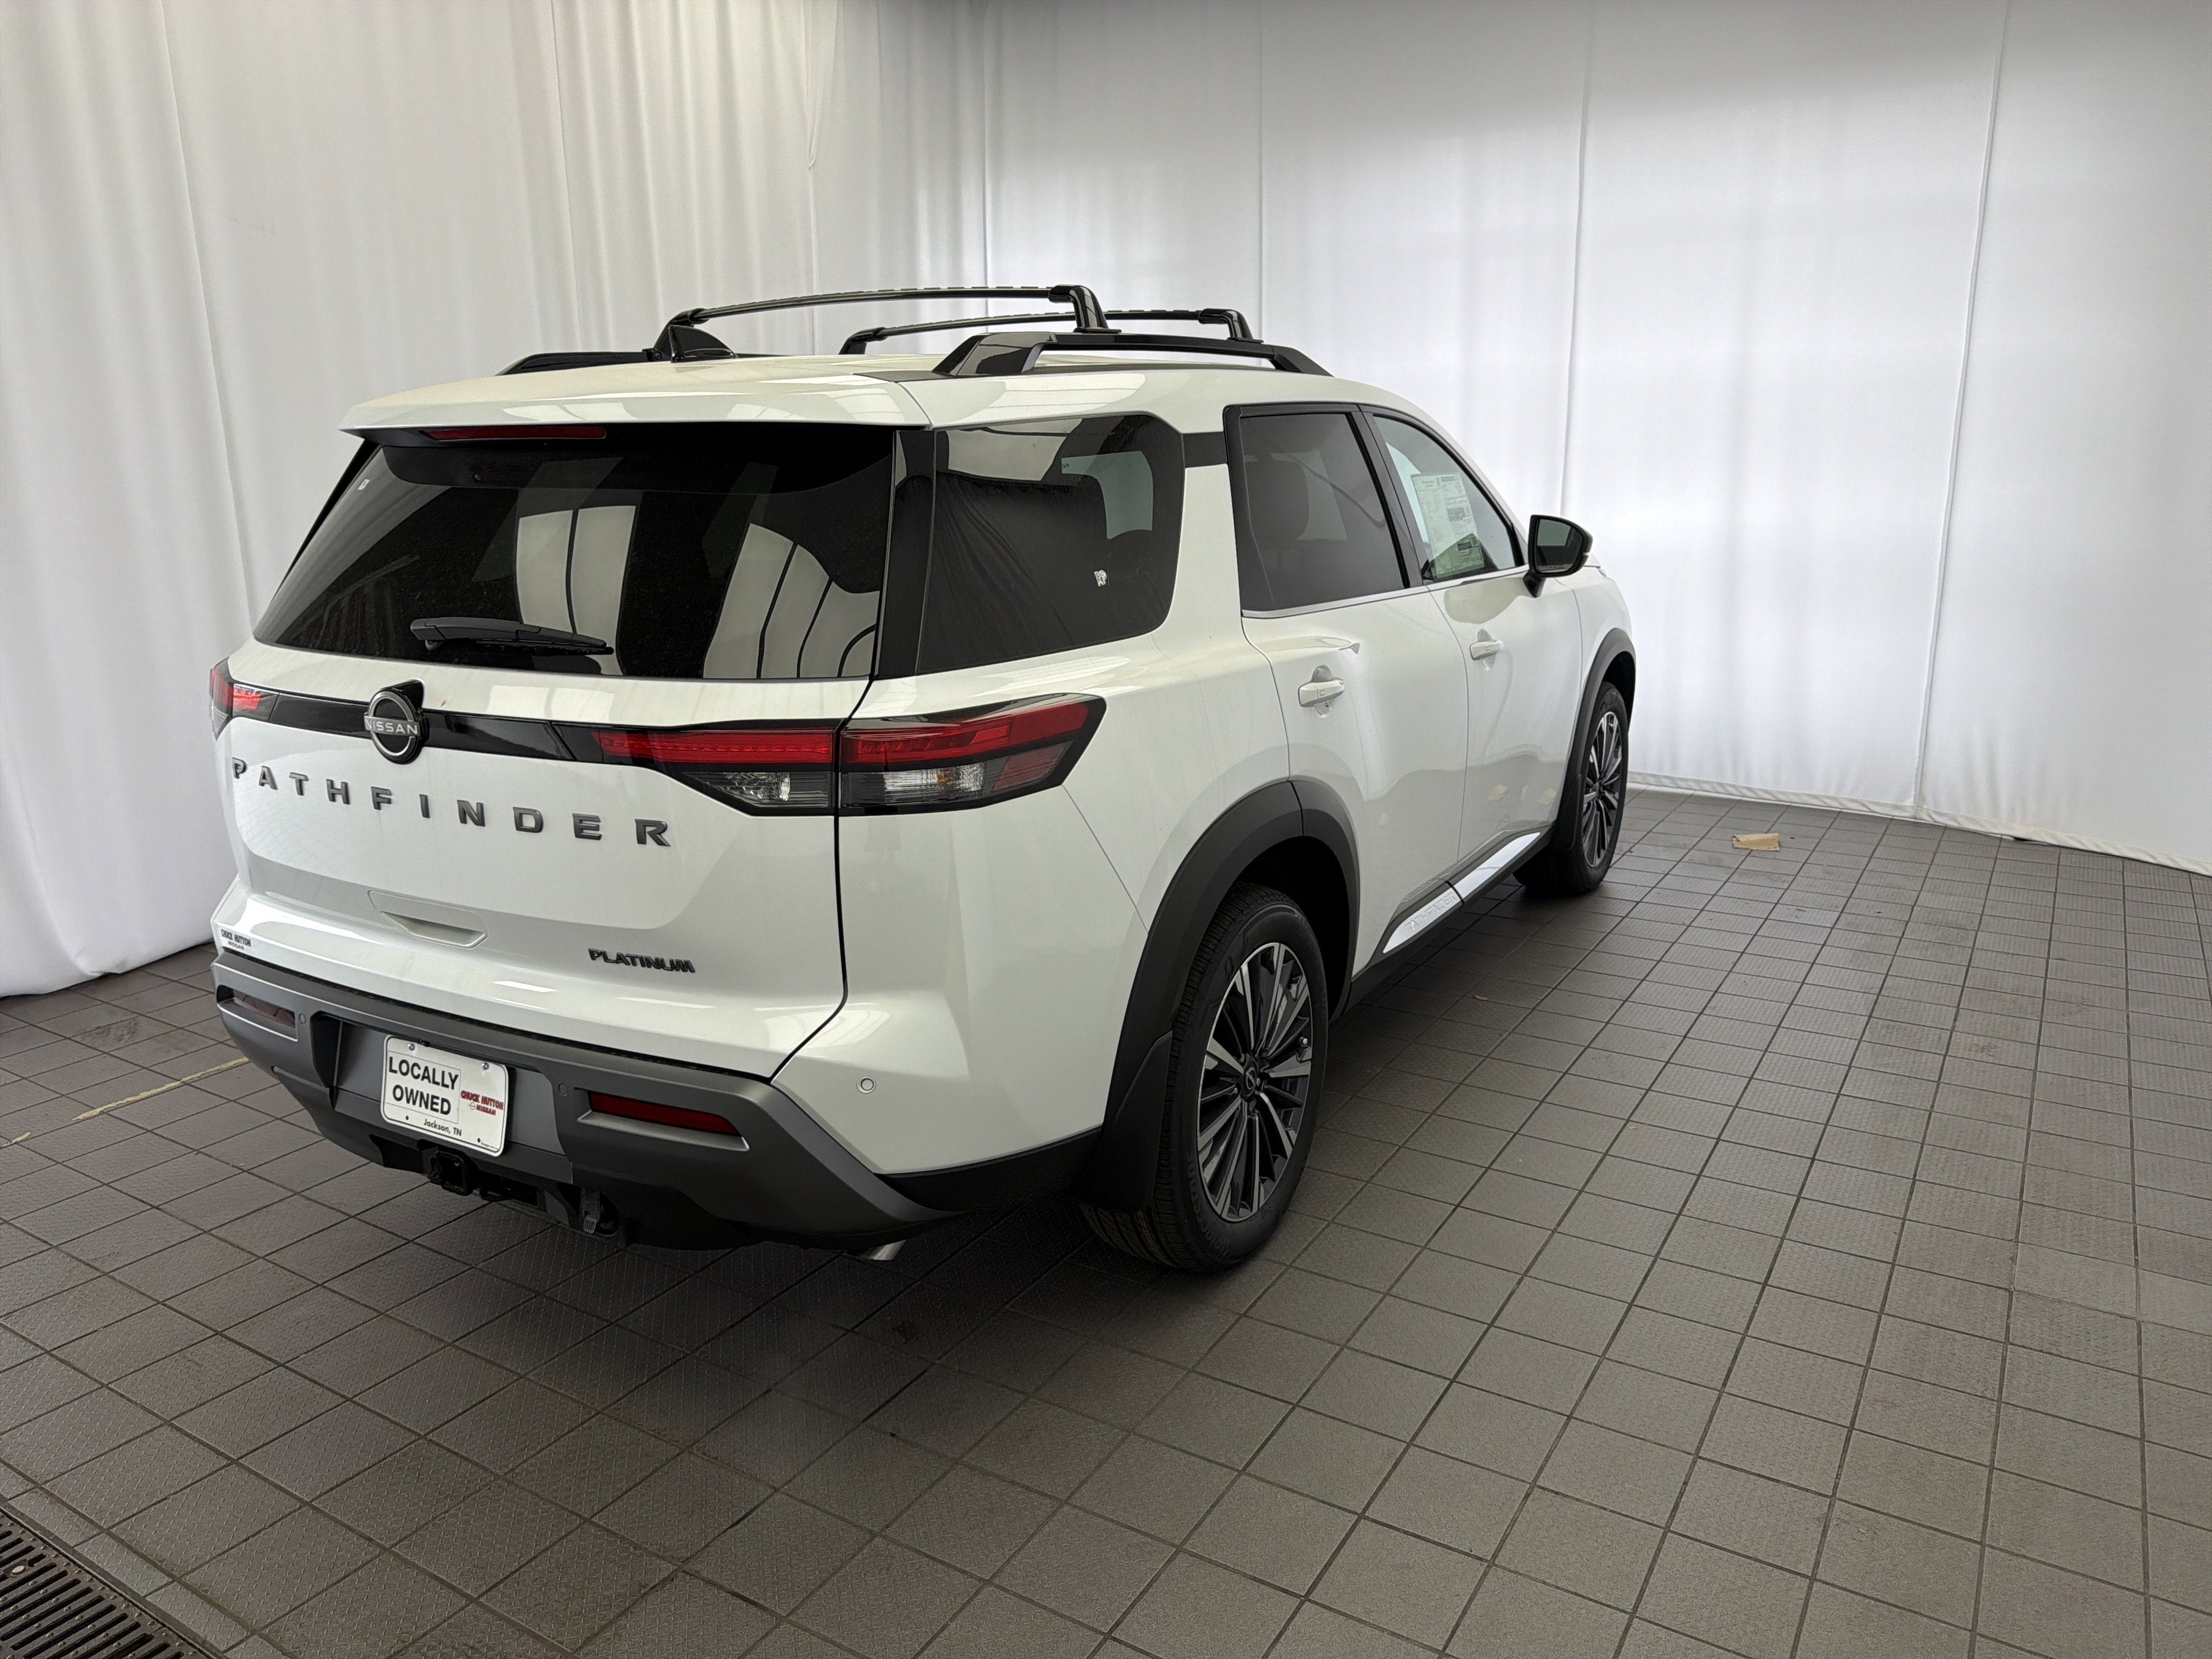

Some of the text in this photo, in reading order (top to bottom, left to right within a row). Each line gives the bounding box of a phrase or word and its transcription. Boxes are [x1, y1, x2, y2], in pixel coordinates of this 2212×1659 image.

[365, 718, 418, 734] NISSAN
[232, 757, 671, 847] PATHFINDER
[588, 948, 696, 973] PLATINUM
[389, 1057, 459, 1090] LOCALLY
[393, 1085, 451, 1115] OWNED
[461, 1090, 504, 1110] CHUCK HUTTON
[476, 1104, 496, 1116] NISSAN
[424, 1118, 462, 1136] Jackson, TN
